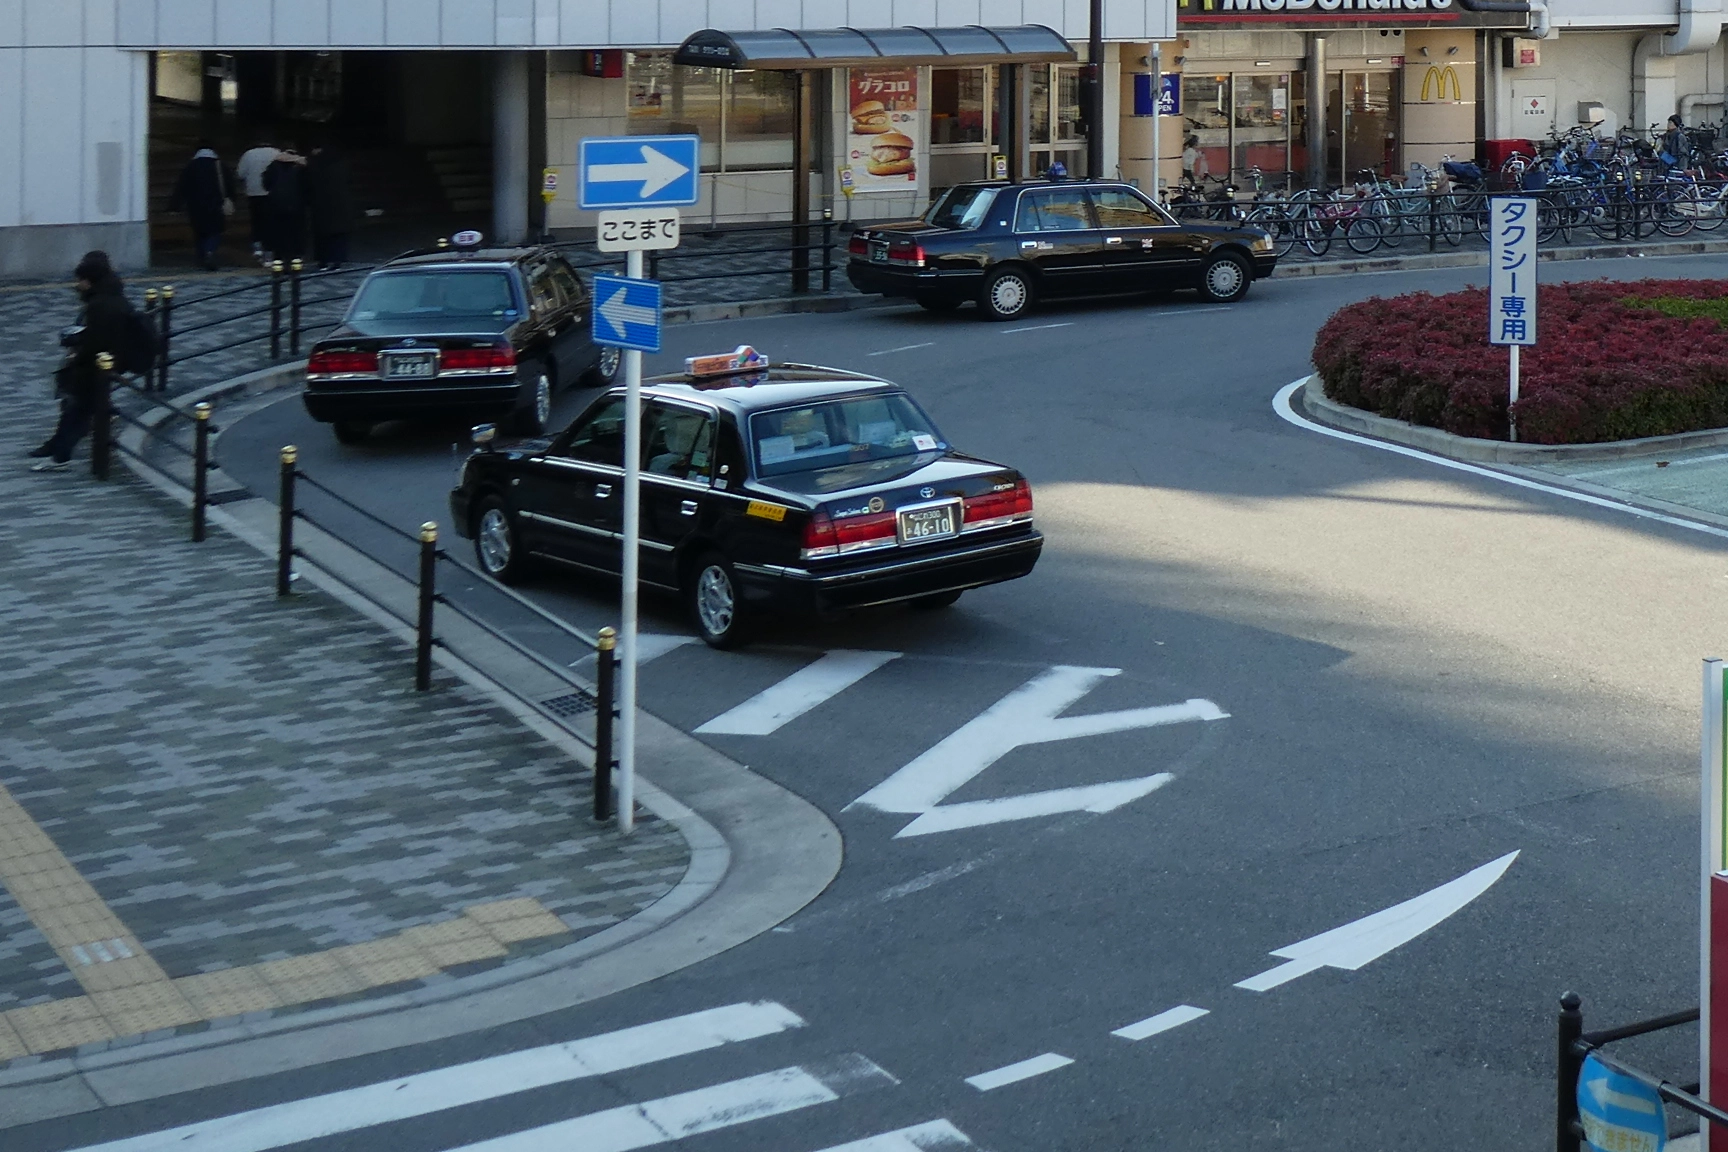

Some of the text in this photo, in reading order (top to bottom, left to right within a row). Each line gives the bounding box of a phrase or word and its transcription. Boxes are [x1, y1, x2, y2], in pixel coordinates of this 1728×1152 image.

[858, 78, 910, 94] グラコロ
[603, 219, 676, 242] ここまで
[1500, 202, 1527, 341] タクシー専用
